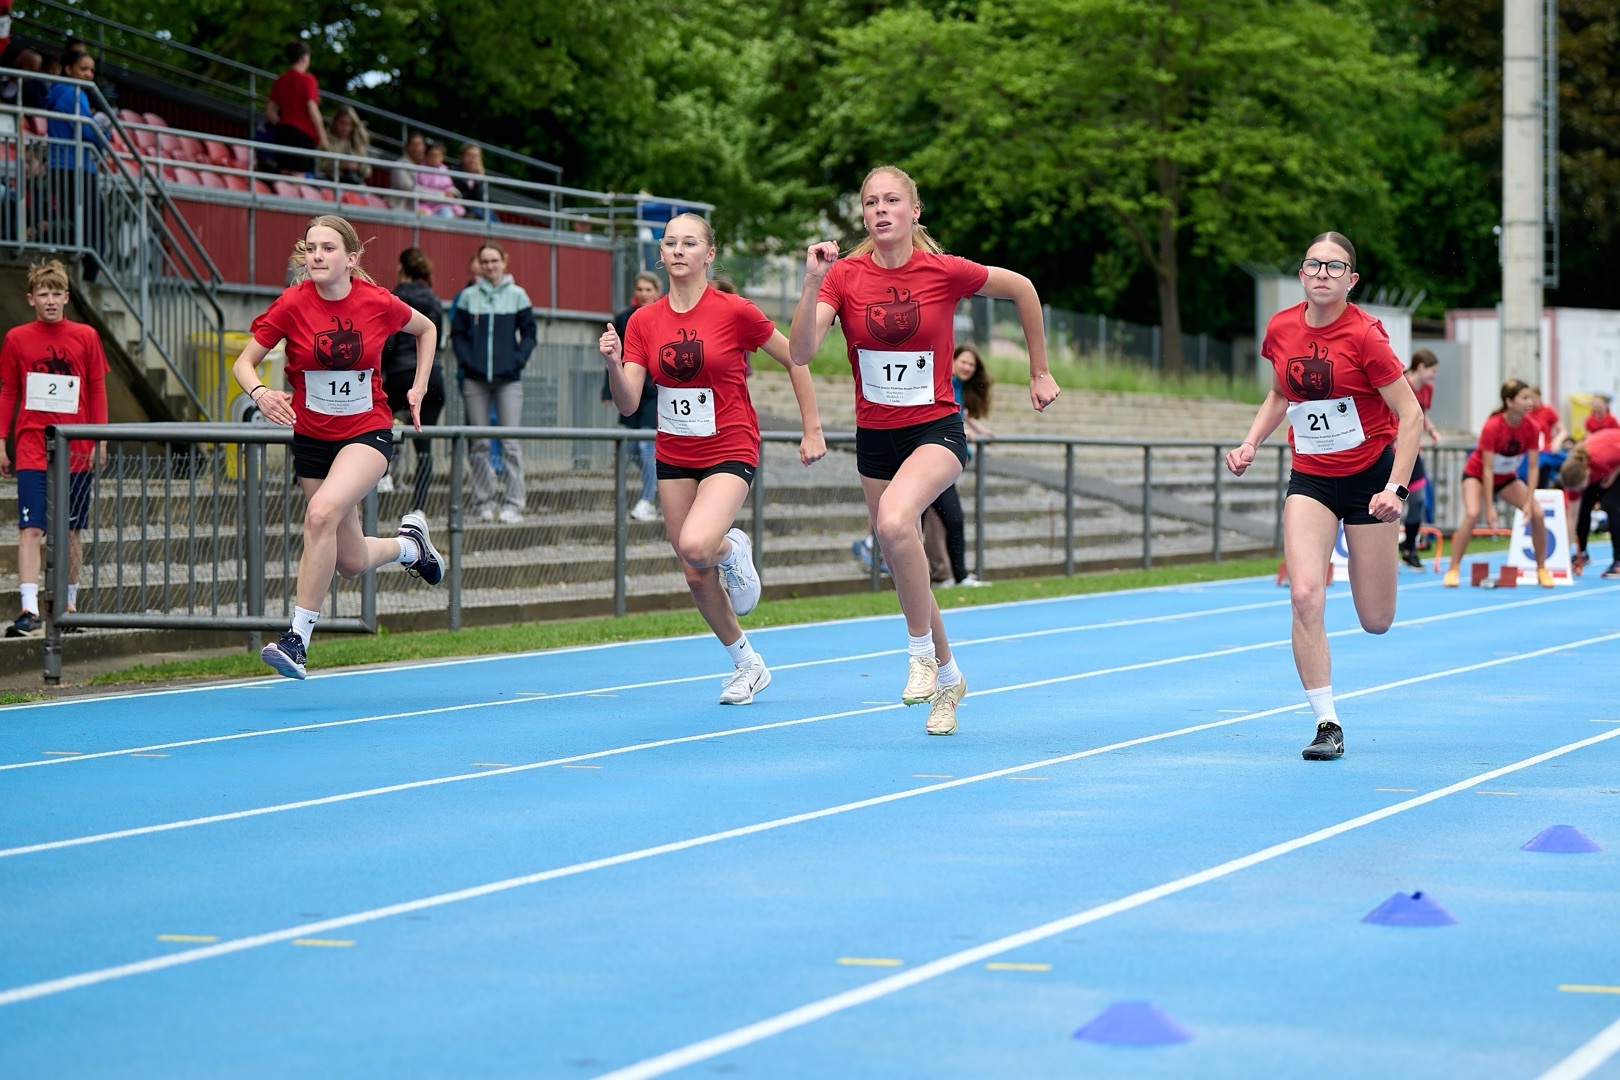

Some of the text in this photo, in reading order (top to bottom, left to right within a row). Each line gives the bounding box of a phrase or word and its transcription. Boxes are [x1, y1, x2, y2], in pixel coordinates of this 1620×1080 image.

[882, 363, 908, 382] 17
[48, 382, 57, 396] 2
[328, 380, 351, 396] 14
[670, 399, 691, 416] 13
[1307, 413, 1330, 431] 21
